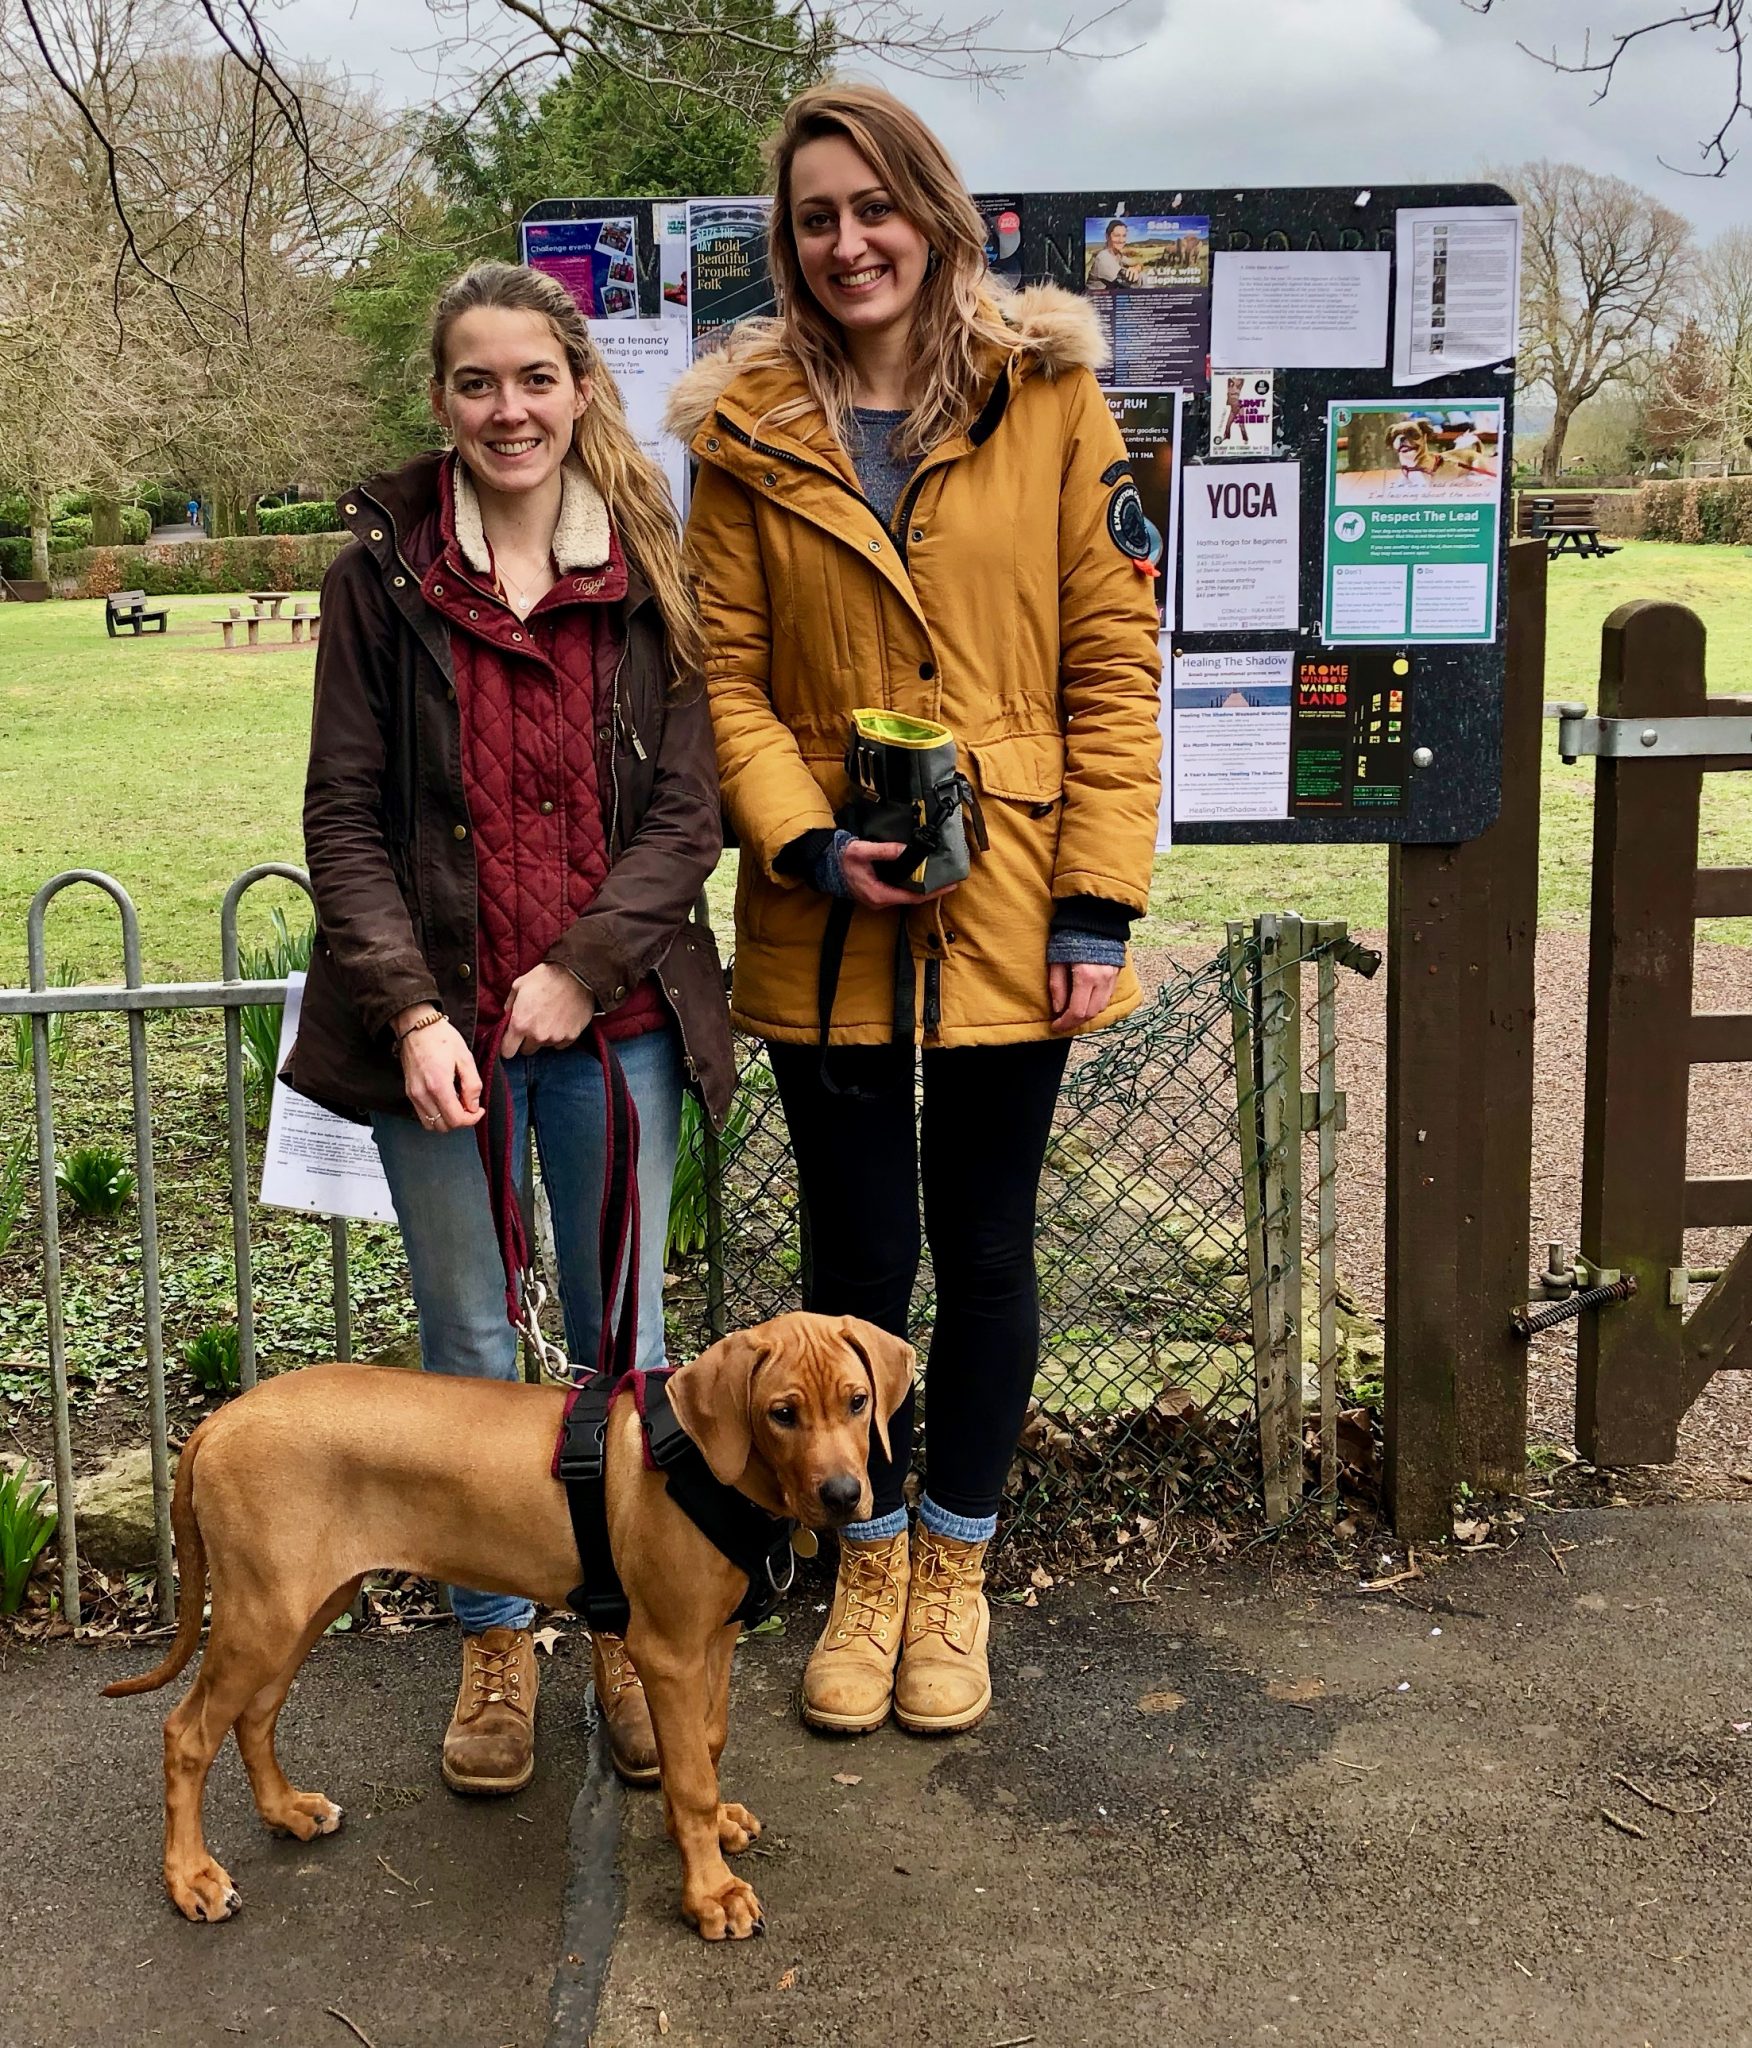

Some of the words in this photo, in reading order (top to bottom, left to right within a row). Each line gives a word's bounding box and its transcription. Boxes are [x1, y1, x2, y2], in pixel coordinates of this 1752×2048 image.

[1147, 221, 1180, 229] Saba
[696, 228, 719, 239] SEIZE
[720, 228, 735, 239] THE
[530, 244, 567, 254] Challenge
[568, 243, 592, 251] events
[696, 240, 712, 252] DAY
[714, 239, 740, 252] Bold
[697, 252, 749, 265] Beautiful
[697, 265, 751, 278] Frontline
[1158, 267, 1177, 276] Life
[1178, 266, 1201, 275] with
[697, 278, 722, 290] Folk
[1146, 275, 1202, 286] Elephants
[618, 337, 625, 345] a
[627, 335, 669, 346] tenancy
[606, 348, 630, 357] things
[632, 349, 643, 357] go
[644, 348, 669, 357] wrong
[1105, 398, 1121, 409] for
[1123, 398, 1148, 409] RUH
[1136, 427, 1161, 435] goodies
[1206, 482, 1278, 519] YOGA
[1371, 511, 1421, 524] Respect
[1423, 510, 1446, 521] The
[1449, 509, 1479, 521] Lead
[1221, 539, 1240, 547] Yoga
[1241, 538, 1251, 546] for
[1253, 538, 1288, 546] Beginners
[1182, 658, 1221, 669] Healing
[1223, 657, 1243, 666] The
[1245, 656, 1288, 665] Shadow
[1300, 664, 1349, 676] FROME
[1300, 683, 1347, 693] WANDER
[1299, 693, 1348, 706] LAND
[1188, 805, 1278, 815] HealingTheShadow.co.uk
